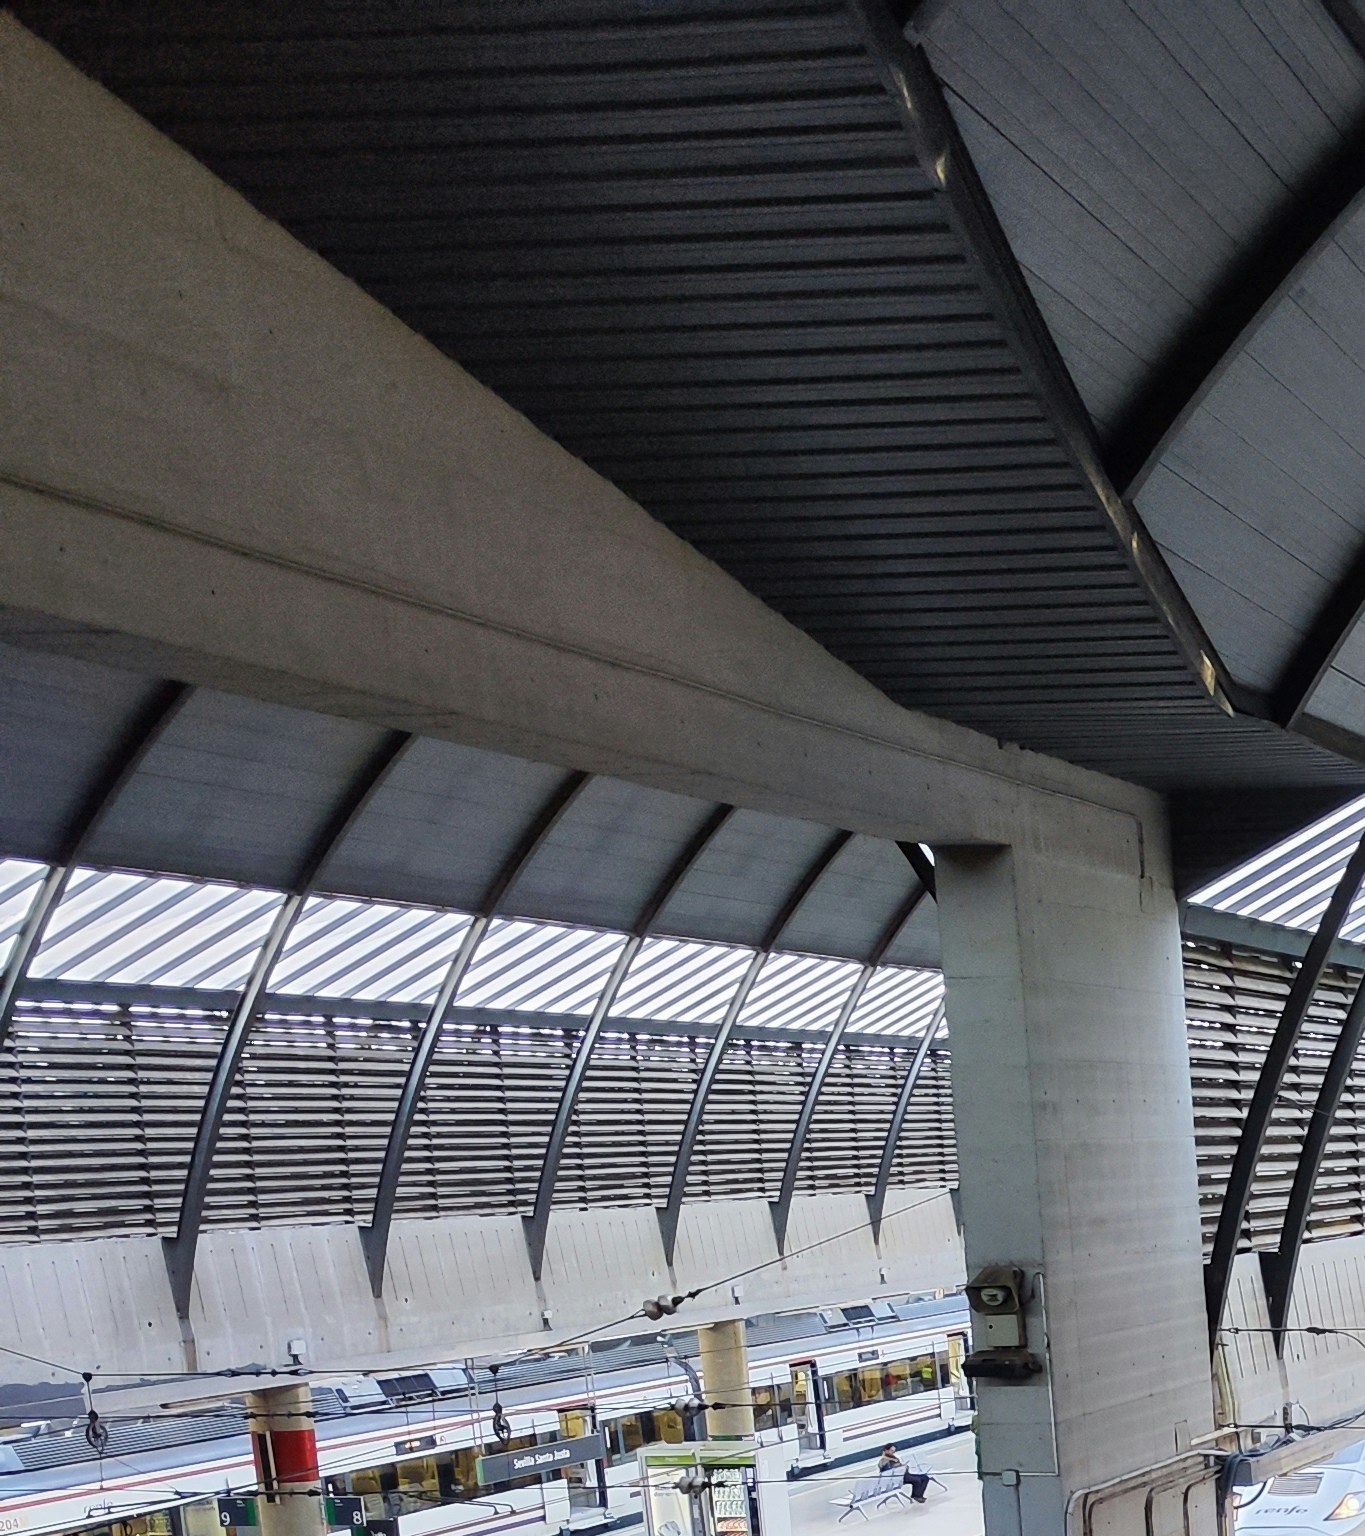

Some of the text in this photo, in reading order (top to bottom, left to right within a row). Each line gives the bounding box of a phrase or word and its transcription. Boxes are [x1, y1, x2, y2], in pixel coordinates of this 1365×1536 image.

[513, 1449, 570, 1469] Sevilla Santa Justa
[220, 1511, 231, 1526] 9
[352, 1510, 363, 1525] 8
[1255, 1505, 1309, 1517] renfe
